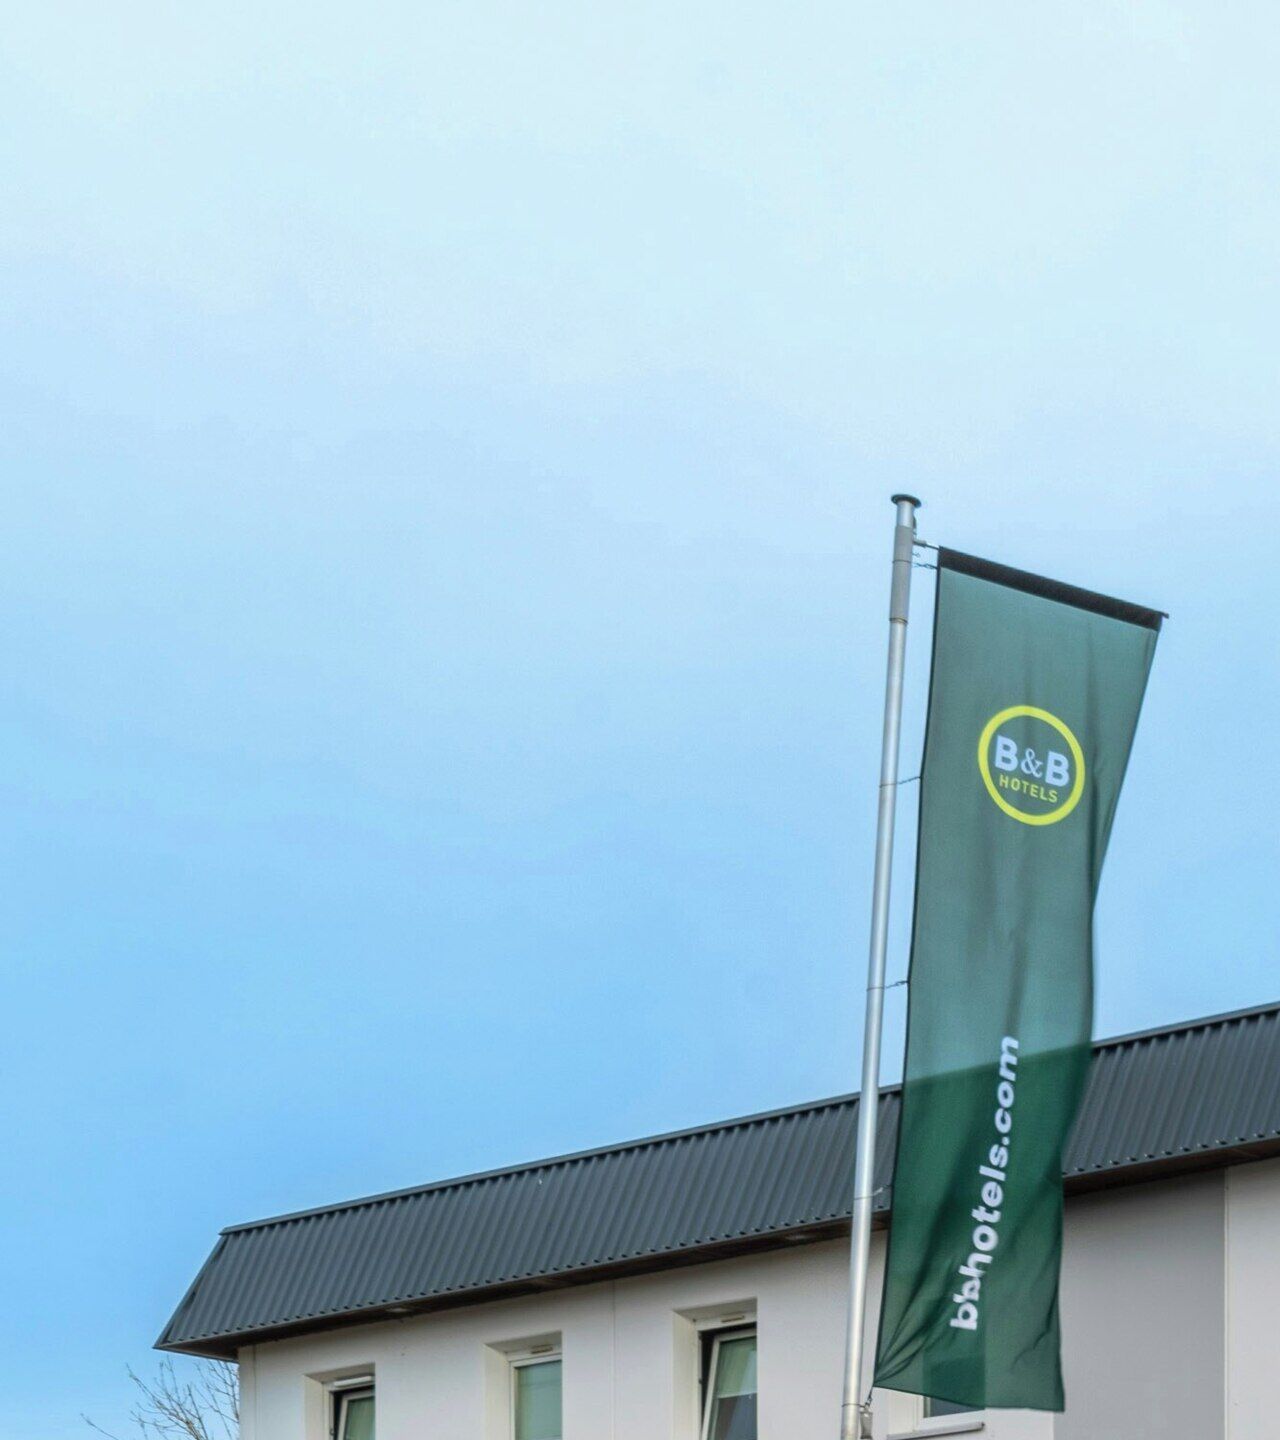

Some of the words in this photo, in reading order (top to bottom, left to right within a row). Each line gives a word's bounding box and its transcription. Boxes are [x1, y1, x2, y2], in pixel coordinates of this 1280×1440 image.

[995, 734, 1070, 787] B&B
[999, 774, 1058, 803] HOTELS
[950, 1035, 1019, 1331] bbhotels.com
